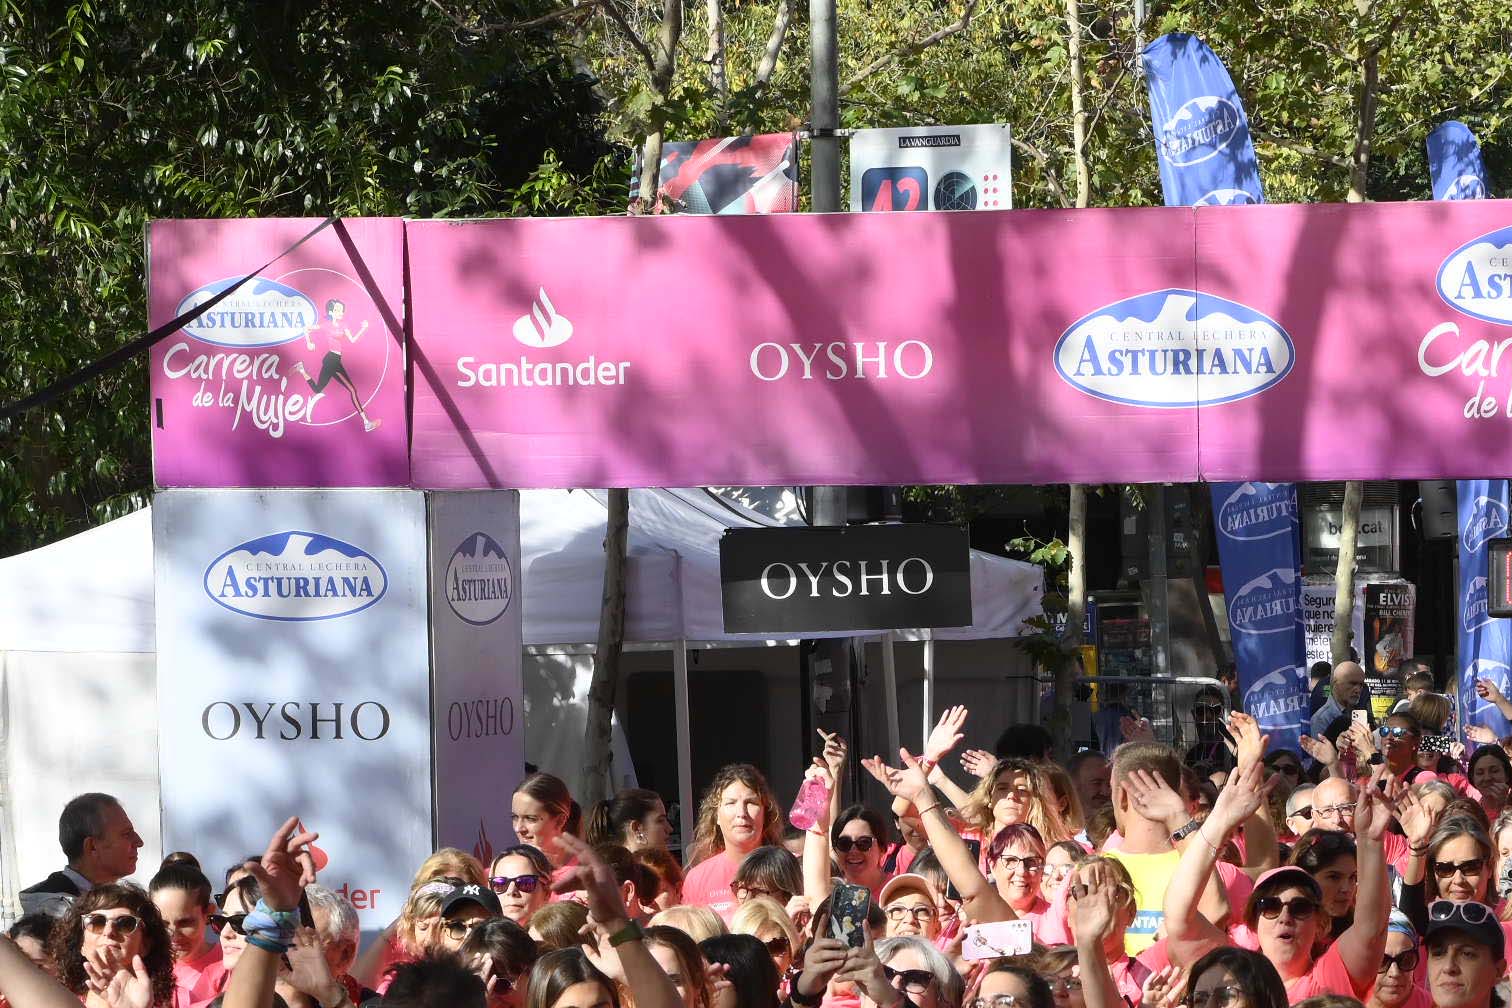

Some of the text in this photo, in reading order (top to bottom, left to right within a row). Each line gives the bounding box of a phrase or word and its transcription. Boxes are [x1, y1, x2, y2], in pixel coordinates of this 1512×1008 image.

[911, 136, 960, 147] VANGUARDIA
[1110, 328, 1270, 342] CENTRAL LECHERA
[163, 342, 280, 380] Carrera
[457, 355, 631, 388] Santander
[749, 339, 934, 382] OYSHO
[1073, 334, 1276, 379] ASTURIANA
[192, 376, 326, 438] de la Mujer
[1463, 381, 1501, 419] de
[1329, 520, 1382, 535] b.cat
[219, 564, 375, 599] ASTURIANA
[246, 560, 368, 572] CENTRAL LECHERA
[760, 557, 934, 600] OYSHO
[451, 573, 510, 602] ASTURIANA
[1379, 592, 1410, 606] ELVIS
[1304, 610, 1321, 622] que
[201, 700, 390, 741] OYSHO
[448, 696, 515, 742] OYSHO
